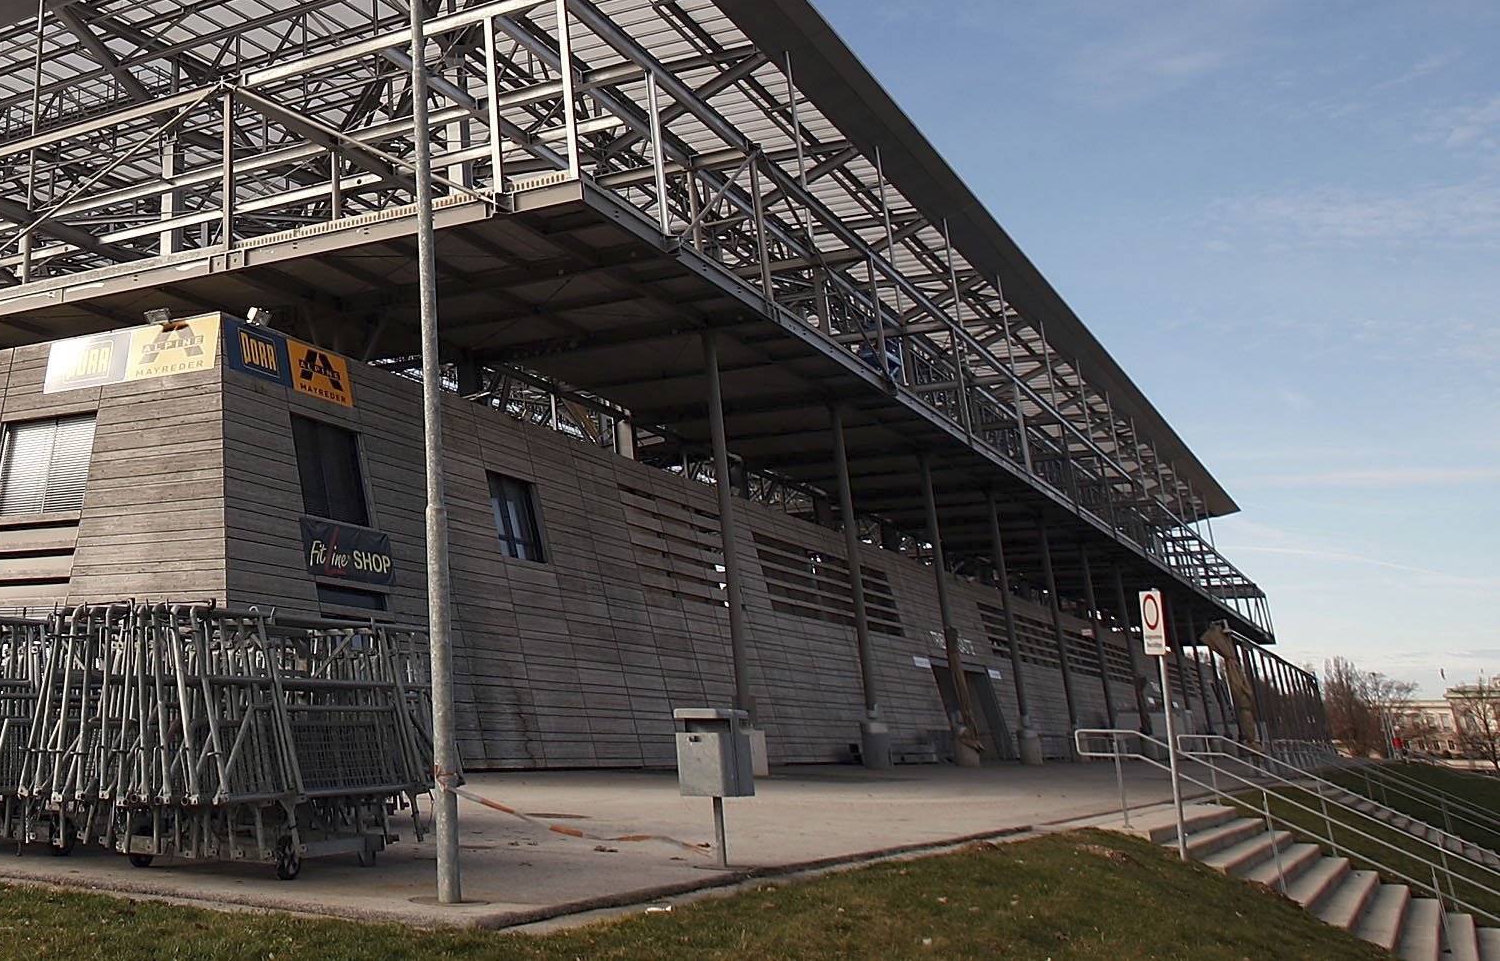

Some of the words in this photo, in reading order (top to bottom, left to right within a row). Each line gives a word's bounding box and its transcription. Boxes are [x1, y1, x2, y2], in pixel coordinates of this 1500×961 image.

[143, 336, 203, 354] ALPINE
[135, 359, 204, 378] MAYREDER
[300, 359, 340, 380] ALPINE
[299, 381, 347, 403] MAYREDER
[353, 549, 392, 574] SHOP
